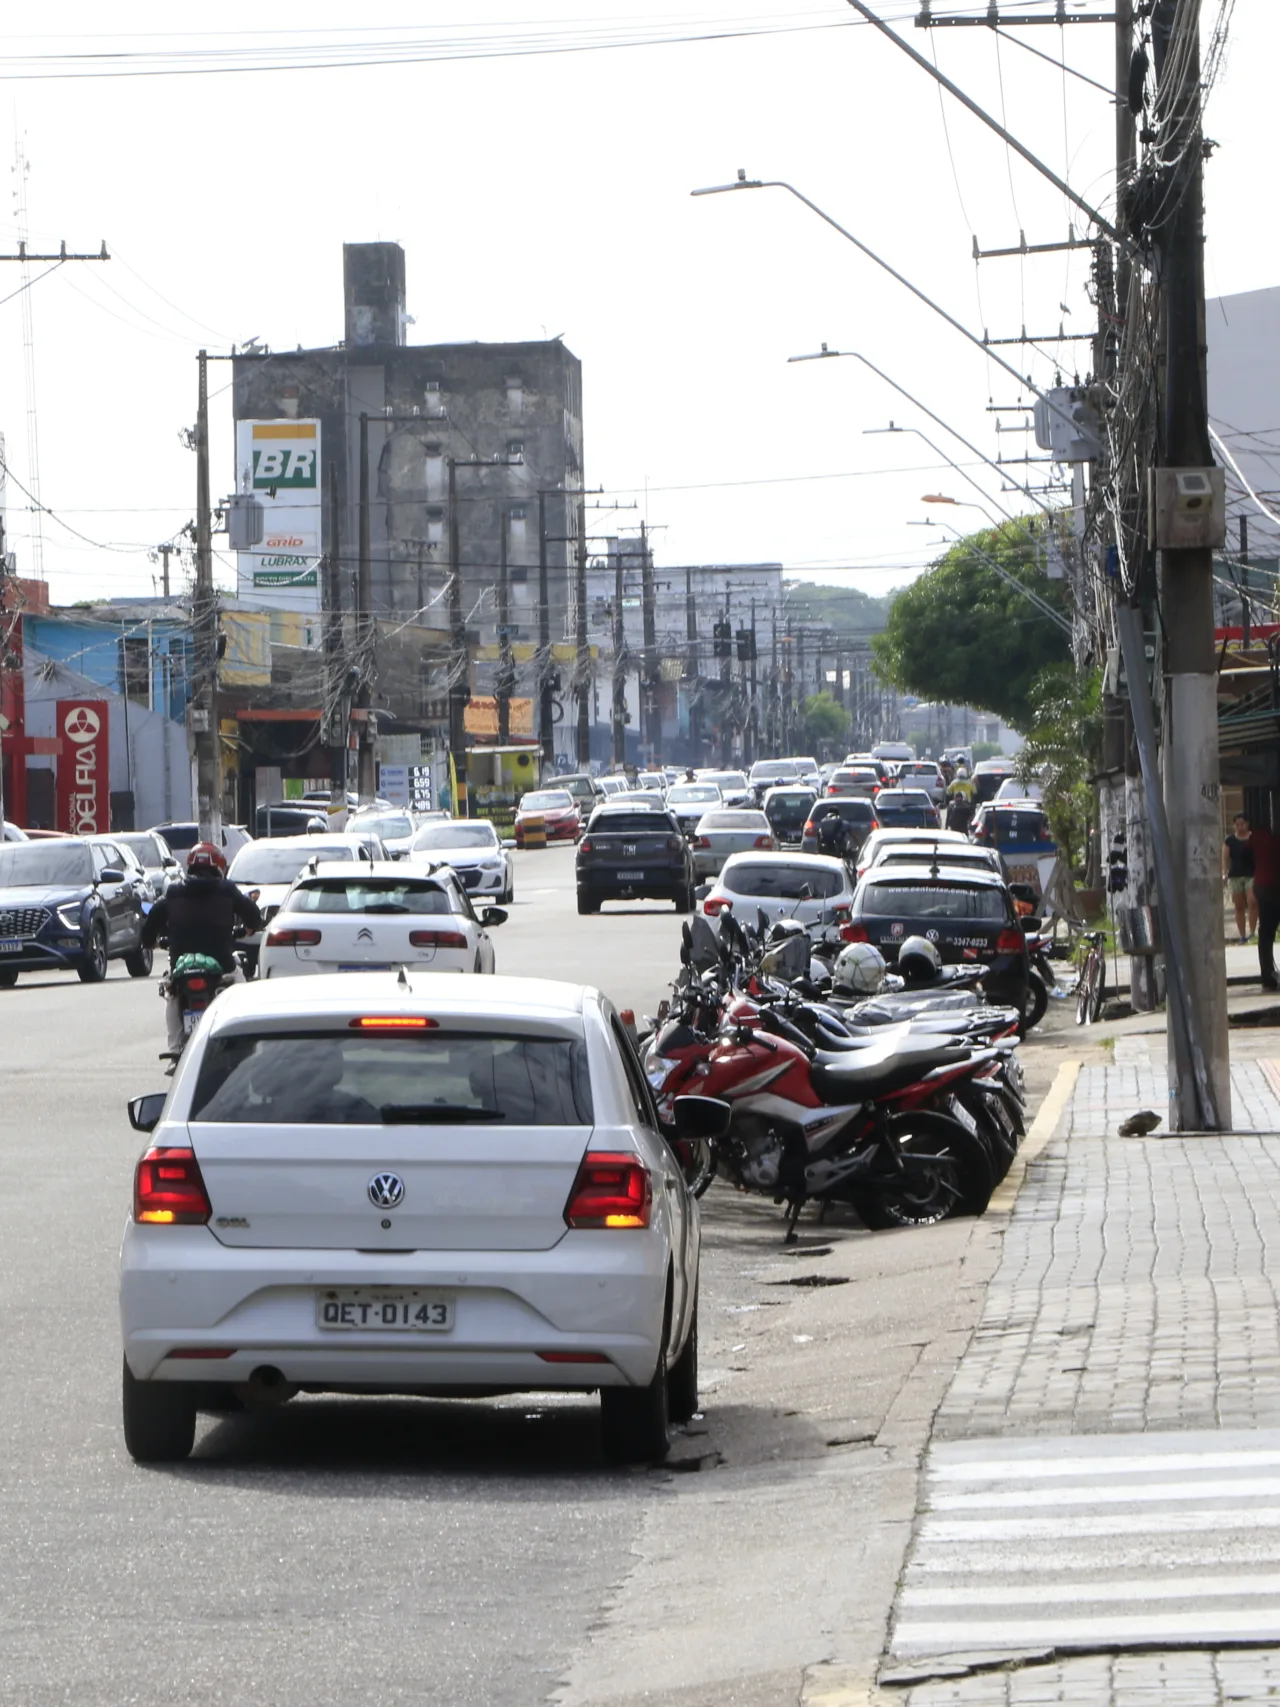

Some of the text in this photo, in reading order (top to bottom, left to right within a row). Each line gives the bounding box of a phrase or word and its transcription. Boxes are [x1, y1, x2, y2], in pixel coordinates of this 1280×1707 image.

[255, 450, 313, 478] BR
[261, 557, 308, 566] LUBRAX
[76, 744, 97, 835] DELFIA
